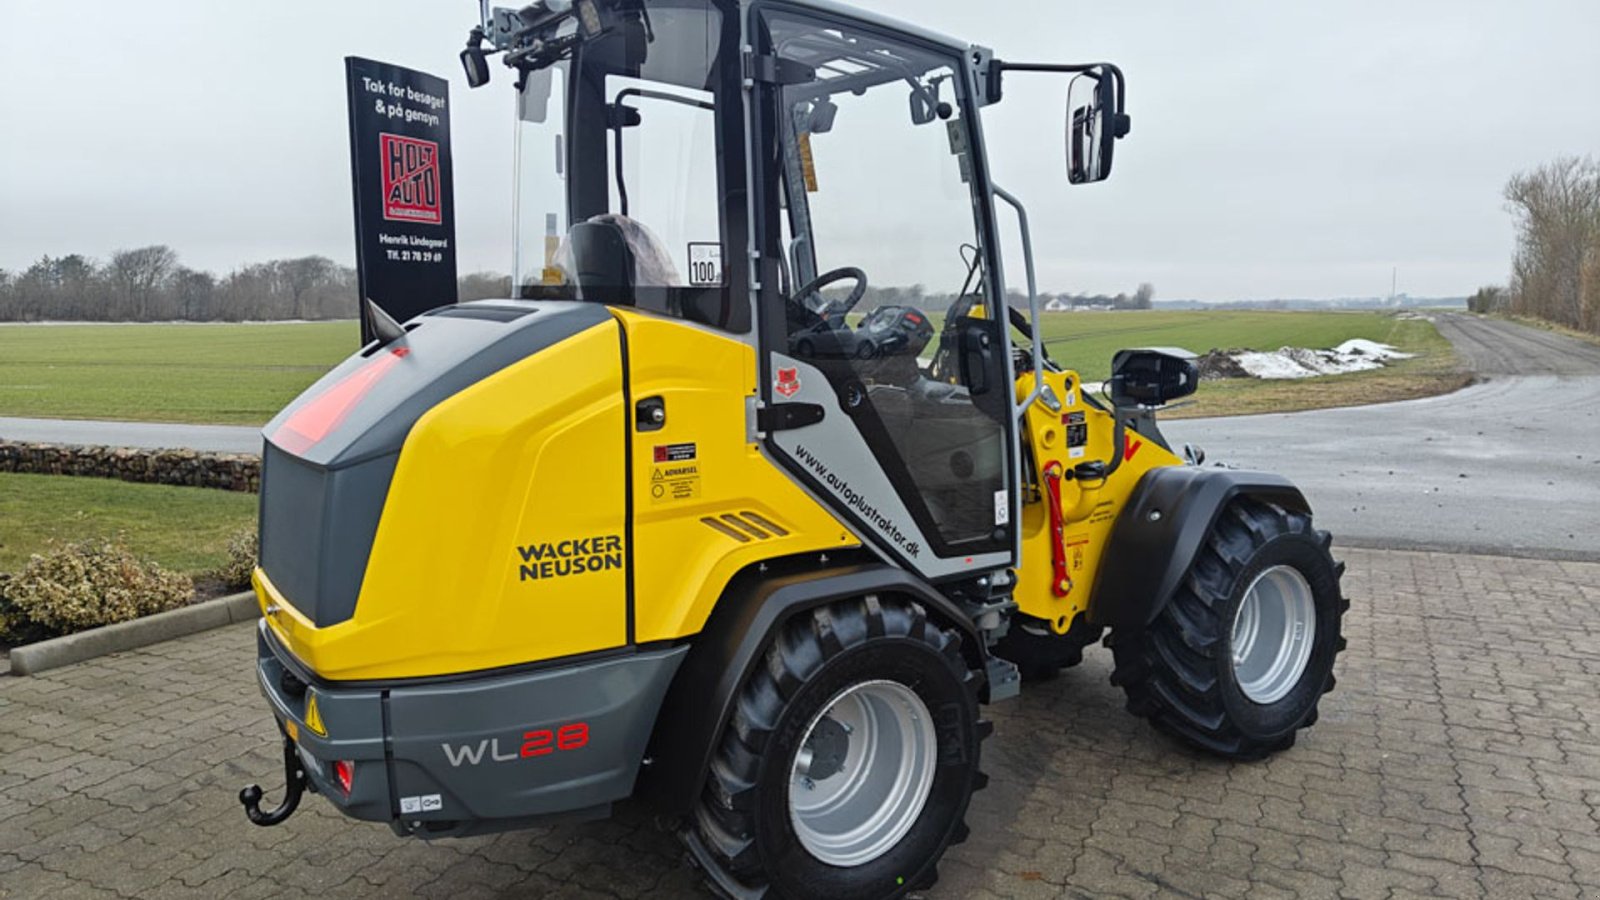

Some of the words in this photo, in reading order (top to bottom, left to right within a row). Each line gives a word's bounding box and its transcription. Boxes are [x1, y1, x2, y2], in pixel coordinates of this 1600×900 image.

[362, 77, 386, 95] Tak
[388, 82, 406, 98] for
[407, 86, 445, 110] besøget
[375, 99, 386, 114] &
[388, 102, 404, 119] på
[405, 107, 440, 127] gensyn
[388, 138, 433, 183] HOLT
[389, 166, 437, 208] AUTO
[379, 233, 408, 246] Henrik
[401, 250, 411, 261] 21
[692, 261, 715, 282] 100
[794, 444, 920, 559] www.autoplustraktor.dk
[517, 534, 622, 563] WACKER
[520, 553, 622, 581] NEUSON
[441, 722, 590, 767] WL28
